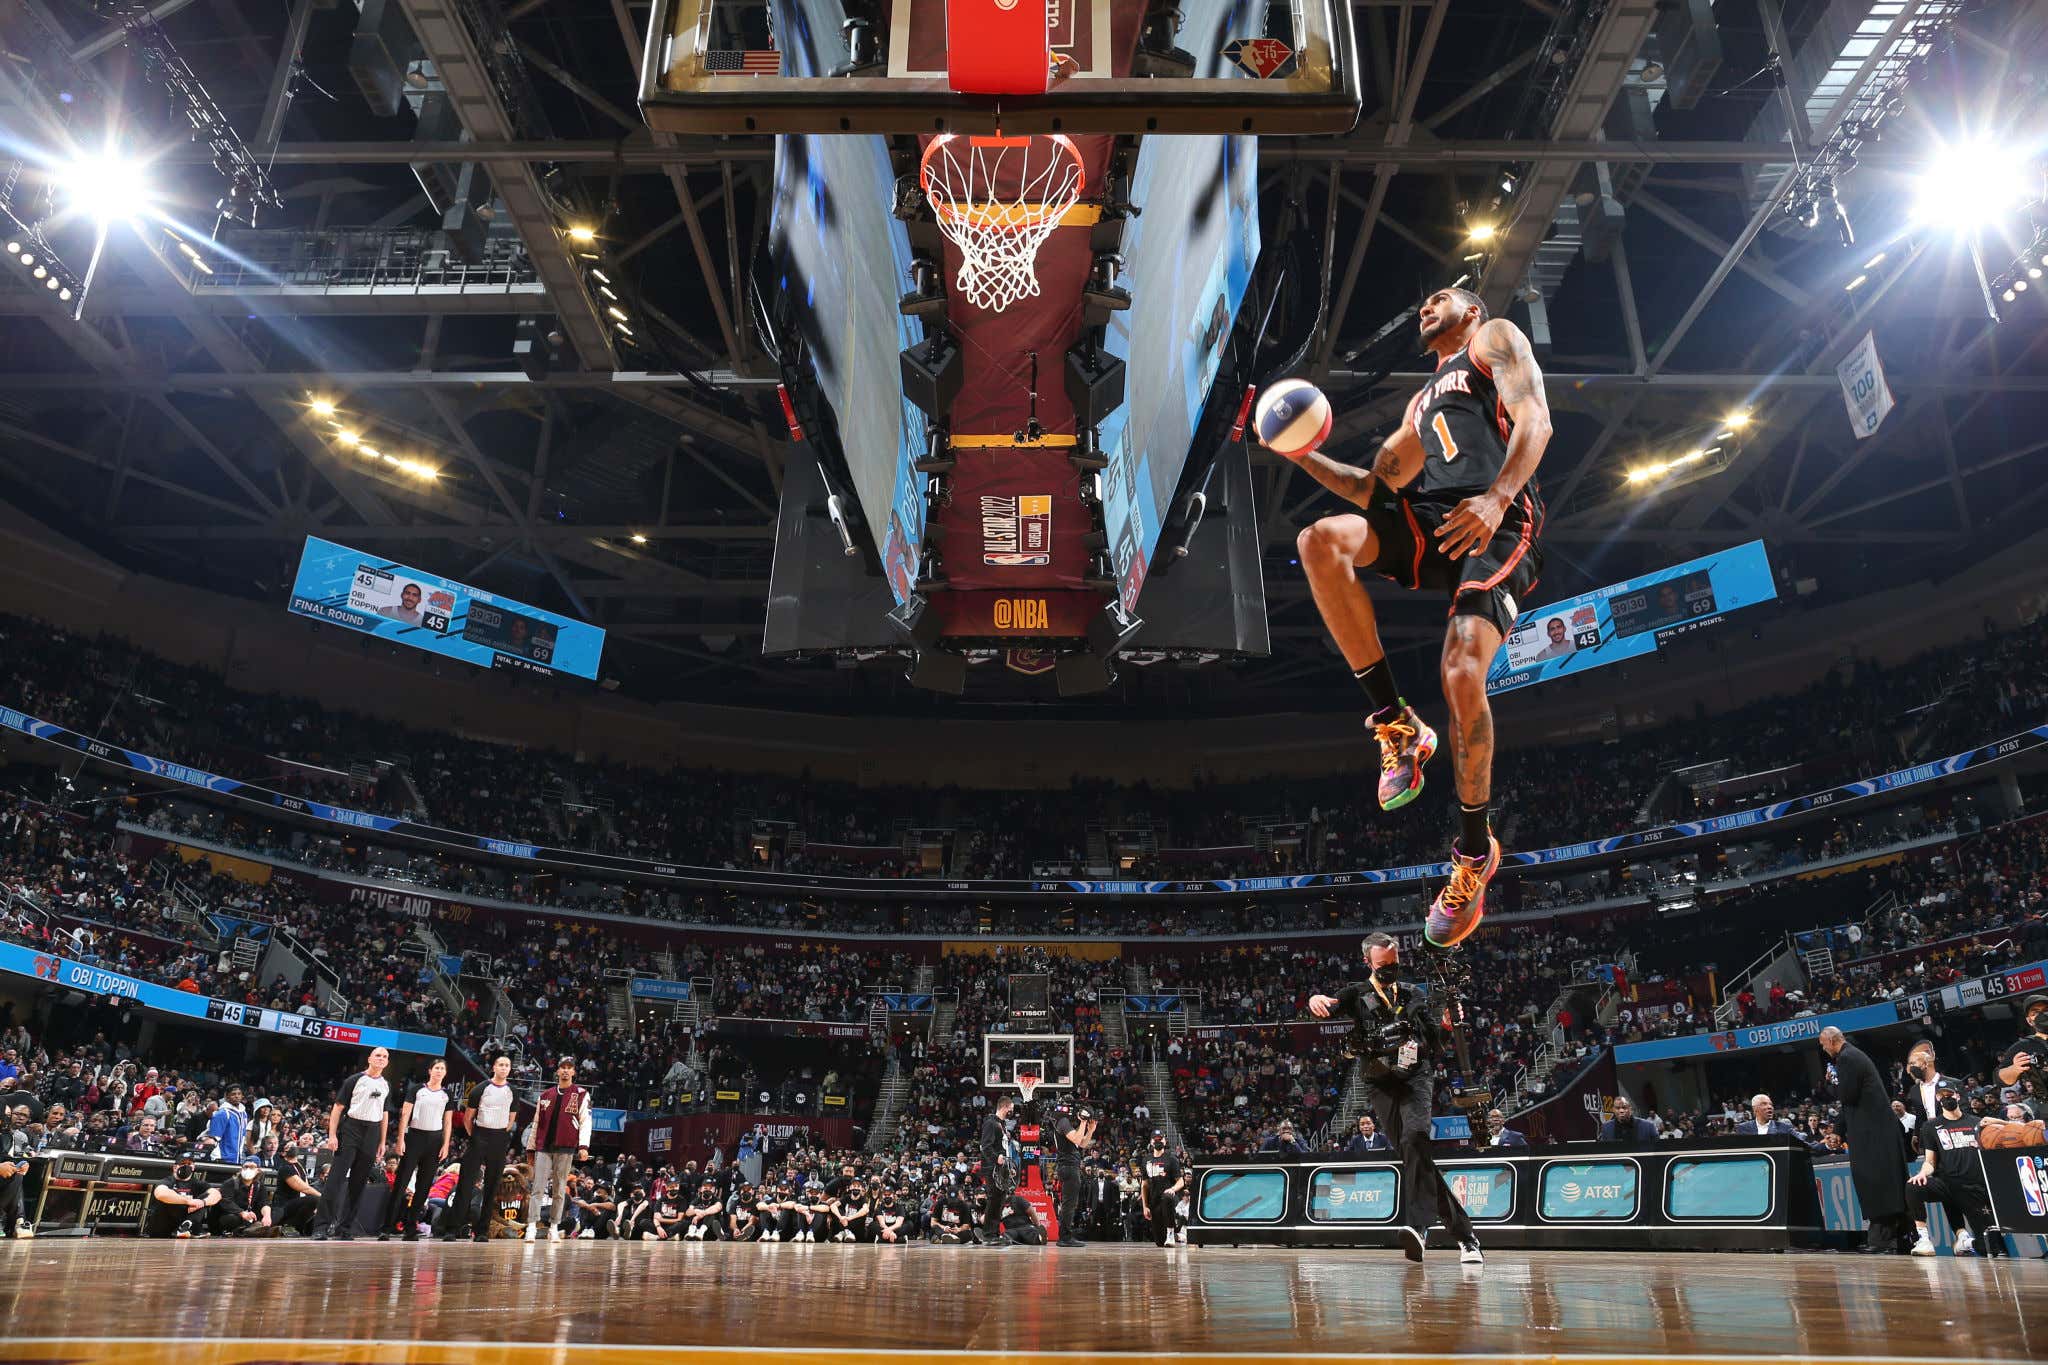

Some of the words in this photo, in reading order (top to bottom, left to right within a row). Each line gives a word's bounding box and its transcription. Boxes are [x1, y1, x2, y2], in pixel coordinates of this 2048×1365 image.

[1434, 369, 1471, 399] YORK
[1851, 370, 1874, 403] 100
[1431, 411, 1459, 462] 1
[1108, 455, 1121, 502] 45
[980, 496, 1016, 518] 2022
[1119, 534, 1134, 576] 45
[356, 573, 373, 587] 45
[352, 590, 366, 600] OBI
[1125, 579, 1136, 609] 31
[294, 599, 325, 615] FINAL
[327, 607, 365, 626] ROUND
[349, 598, 380, 613] TOPPIN
[1612, 603, 1627, 616] 39
[1630, 597, 1645, 610] 30
[1693, 599, 1710, 613] 69
[994, 599, 1049, 629] @NBA
[427, 616, 444, 630] 45
[1578, 624, 1594, 632] TOTAL
[1508, 635, 1521, 646] 45
[1580, 633, 1596, 646] 45
[1658, 630, 1676, 639] TOTAL
[495, 655, 512, 664] TOTAL
[533, 648, 549, 660] 69
[1511, 656, 1536, 667] TOPPIN
[1499, 673, 1530, 687] ROUND
[3, 711, 25, 729] DUNK
[88, 743, 110, 757] AT&T
[1999, 739, 2020, 753] AT&T
[167, 764, 185, 780] SLAM
[186, 769, 207, 787] DUNK
[1892, 772, 1912, 786] SLAM
[1913, 766, 1935, 781] DUNK
[282, 799, 303, 810] AT&T
[1813, 793, 1833, 805] AT&T
[336, 810, 354, 825] SLAM
[355, 814, 374, 827] DUNK
[1717, 815, 1736, 829] SLAM
[1736, 812, 1755, 826] DUNK
[1643, 832, 1662, 842] AT&T
[498, 843, 514, 856] SLAM
[514, 846, 532, 858] DUNK
[1556, 847, 1572, 860] SLAM
[1572, 845, 1590, 858] DUNK
[1334, 874, 1351, 883] AT&T
[1400, 868, 1415, 880] SLAM
[1105, 882, 1121, 892] SLAM
[1121, 882, 1137, 893] DUNK
[1186, 883, 1203, 891] AT&T
[1251, 879, 1266, 890] SLAM
[1267, 877, 1283, 889] DUNK
[71, 967, 93, 987] OBI
[95, 972, 139, 998] TOPPIN
[1987, 977, 2004, 995] 45
[2006, 976, 2022, 992] 31
[2032, 974, 2042, 982] WIN
[1962, 984, 1983, 998] TOTAL
[1911, 997, 1926, 1015] 45
[225, 1006, 241, 1021] 45
[280, 1019, 301, 1029] TOTAL
[305, 1021, 321, 1035] 45
[1325, 1026, 1333, 1034] ALL
[1333, 1025, 1344, 1033] STAR
[325, 1026, 338, 1038] 31
[842, 1028, 852, 1036] STAR
[1749, 1026, 1771, 1044] OBI
[1774, 1019, 1820, 1039] TOPPIN
[1584, 1094, 1598, 1111] CLE
[777, 1125, 794, 1137] STAR
[63, 1162, 75, 1172] NBA
[75, 1163, 84, 1172] ON
[85, 1164, 96, 1174] TNT
[1468, 1182, 1489, 1195] SLAM
[1584, 1185, 1621, 1199] AT&T
[1348, 1190, 1382, 1203] AT&T
[1467, 1196, 1489, 1206] DUNK
[88, 1199, 108, 1216] ALL
[116, 1200, 142, 1217] STAR
[501, 1200, 520, 1210] UTAH
[504, 1209, 517, 1220] 00
